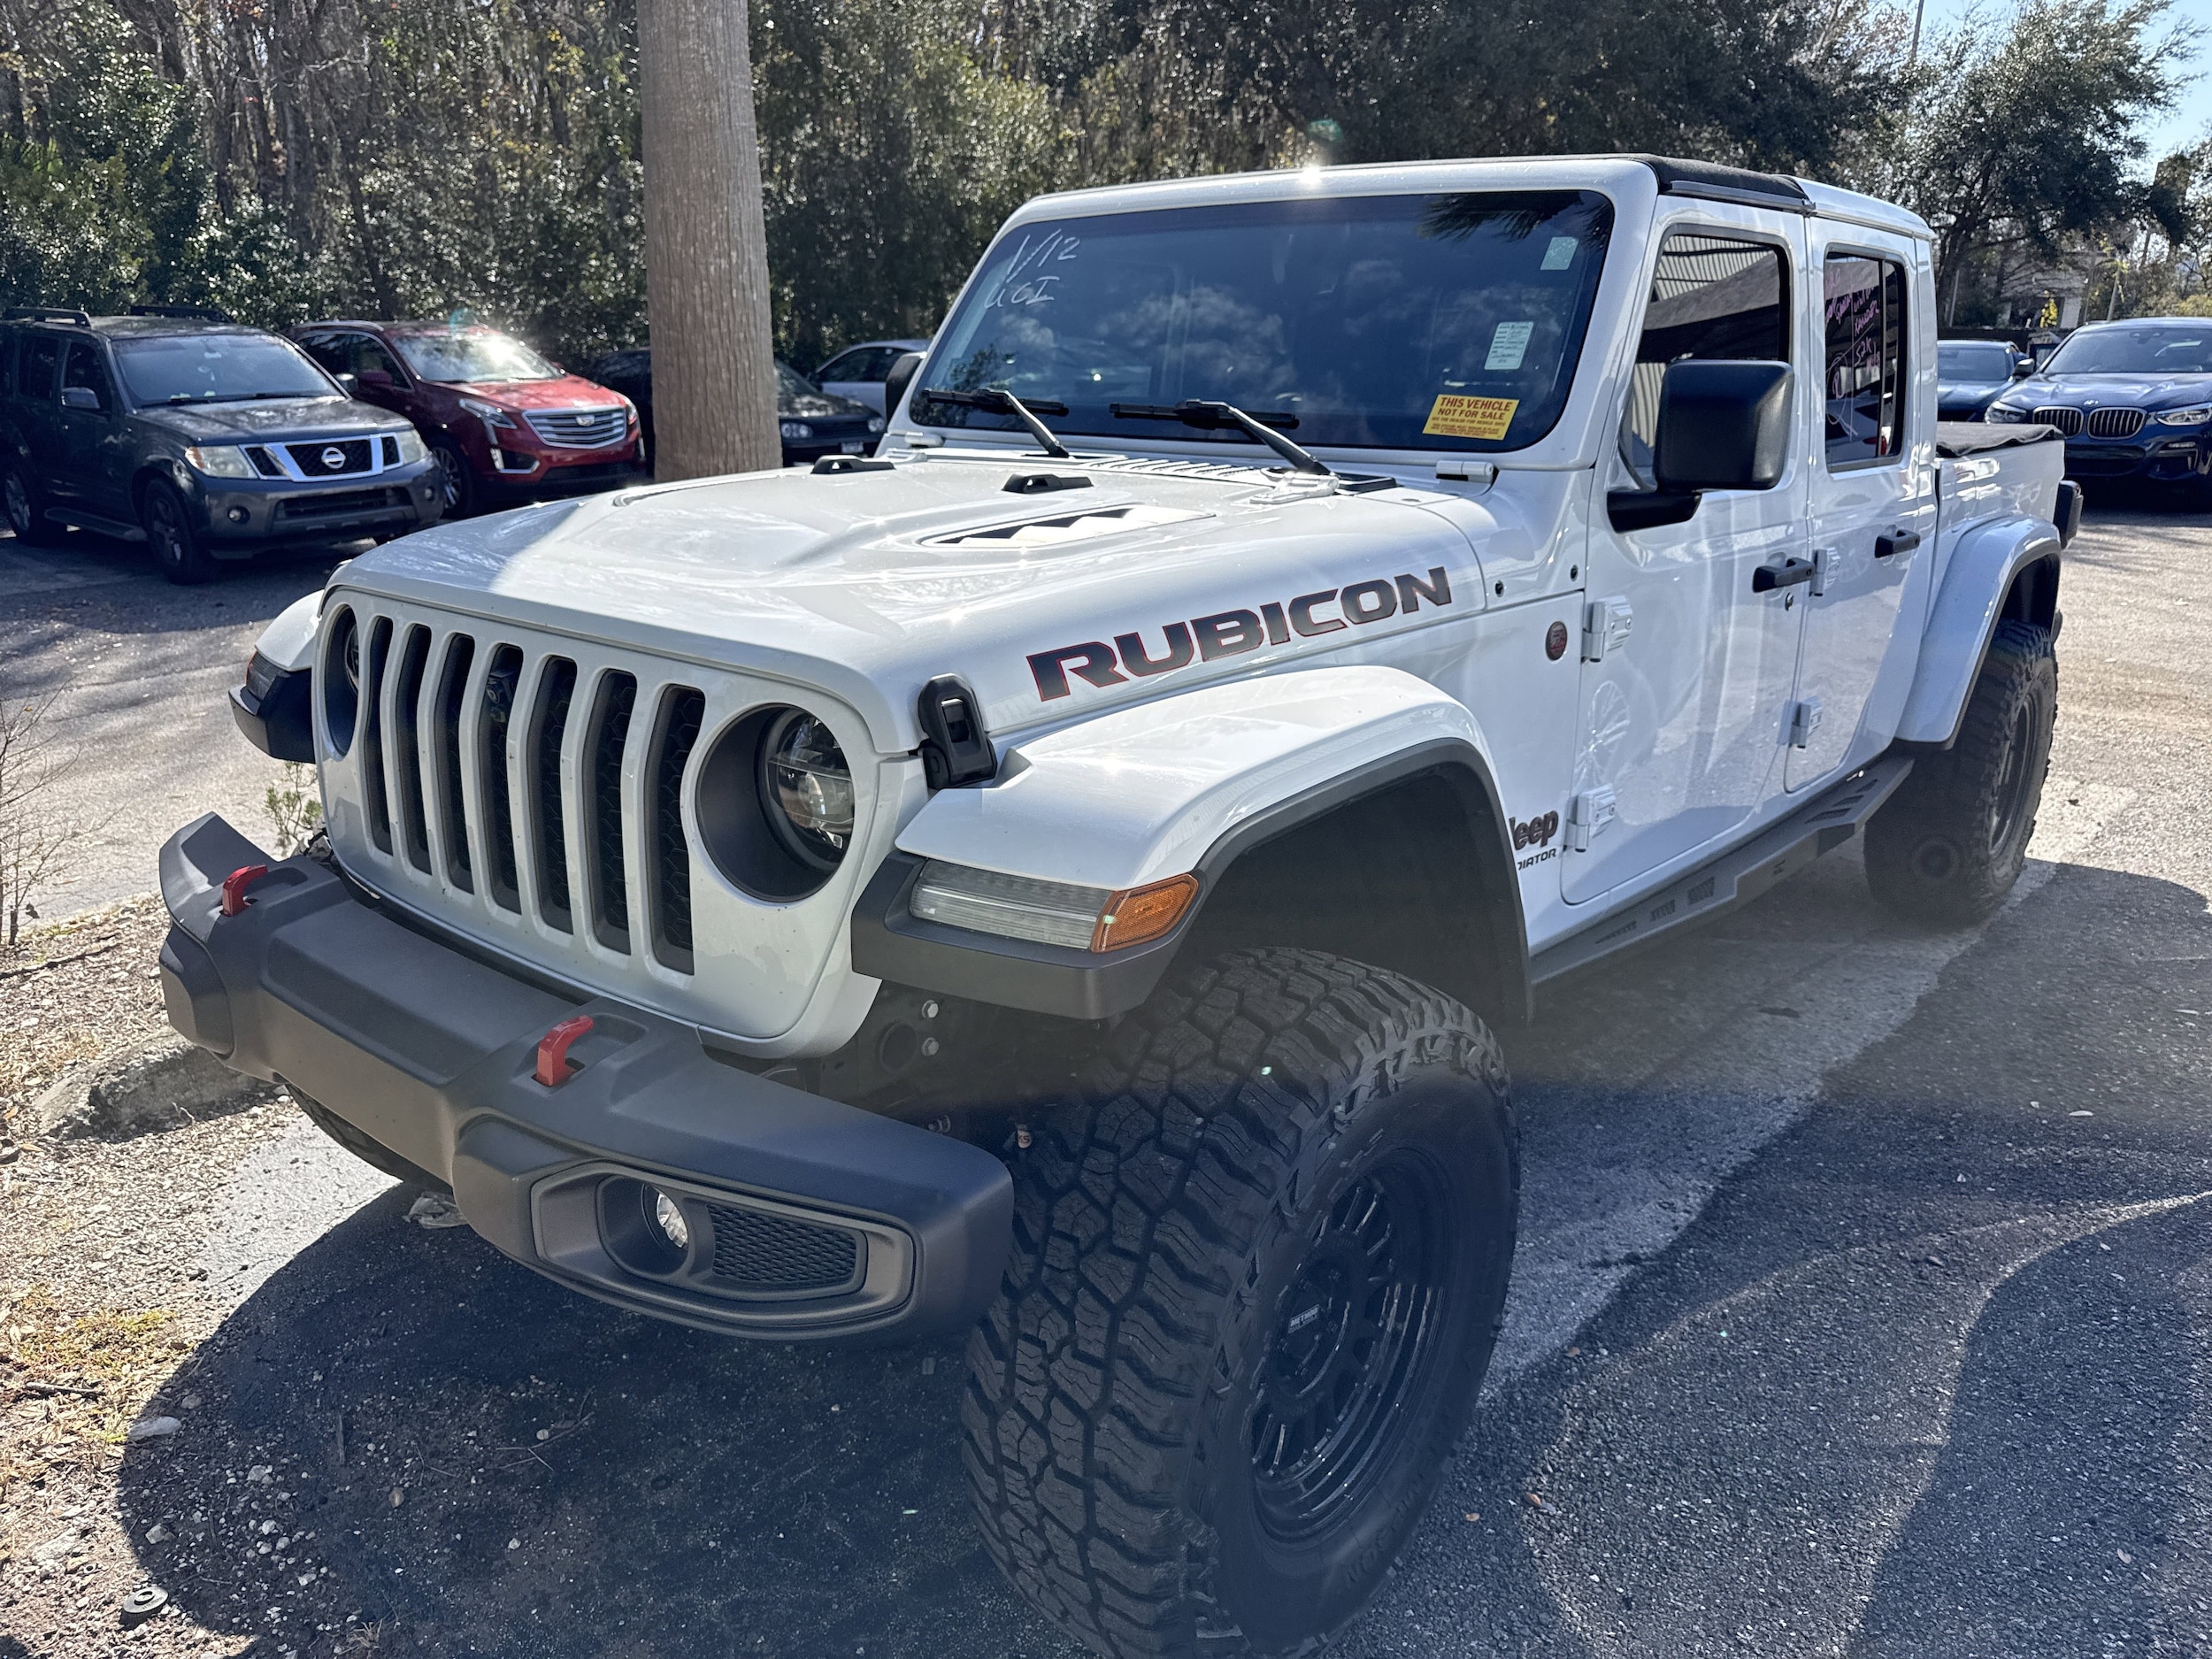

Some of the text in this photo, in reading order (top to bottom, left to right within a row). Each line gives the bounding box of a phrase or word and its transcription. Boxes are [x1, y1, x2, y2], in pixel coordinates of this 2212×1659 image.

[1006, 228, 1080, 283] 1/12
[1438, 408, 1505, 420] NOT FOR SALE
[1440, 397, 1513, 411] THIS VEHICLE
[1025, 565, 1452, 703] RUBICON
